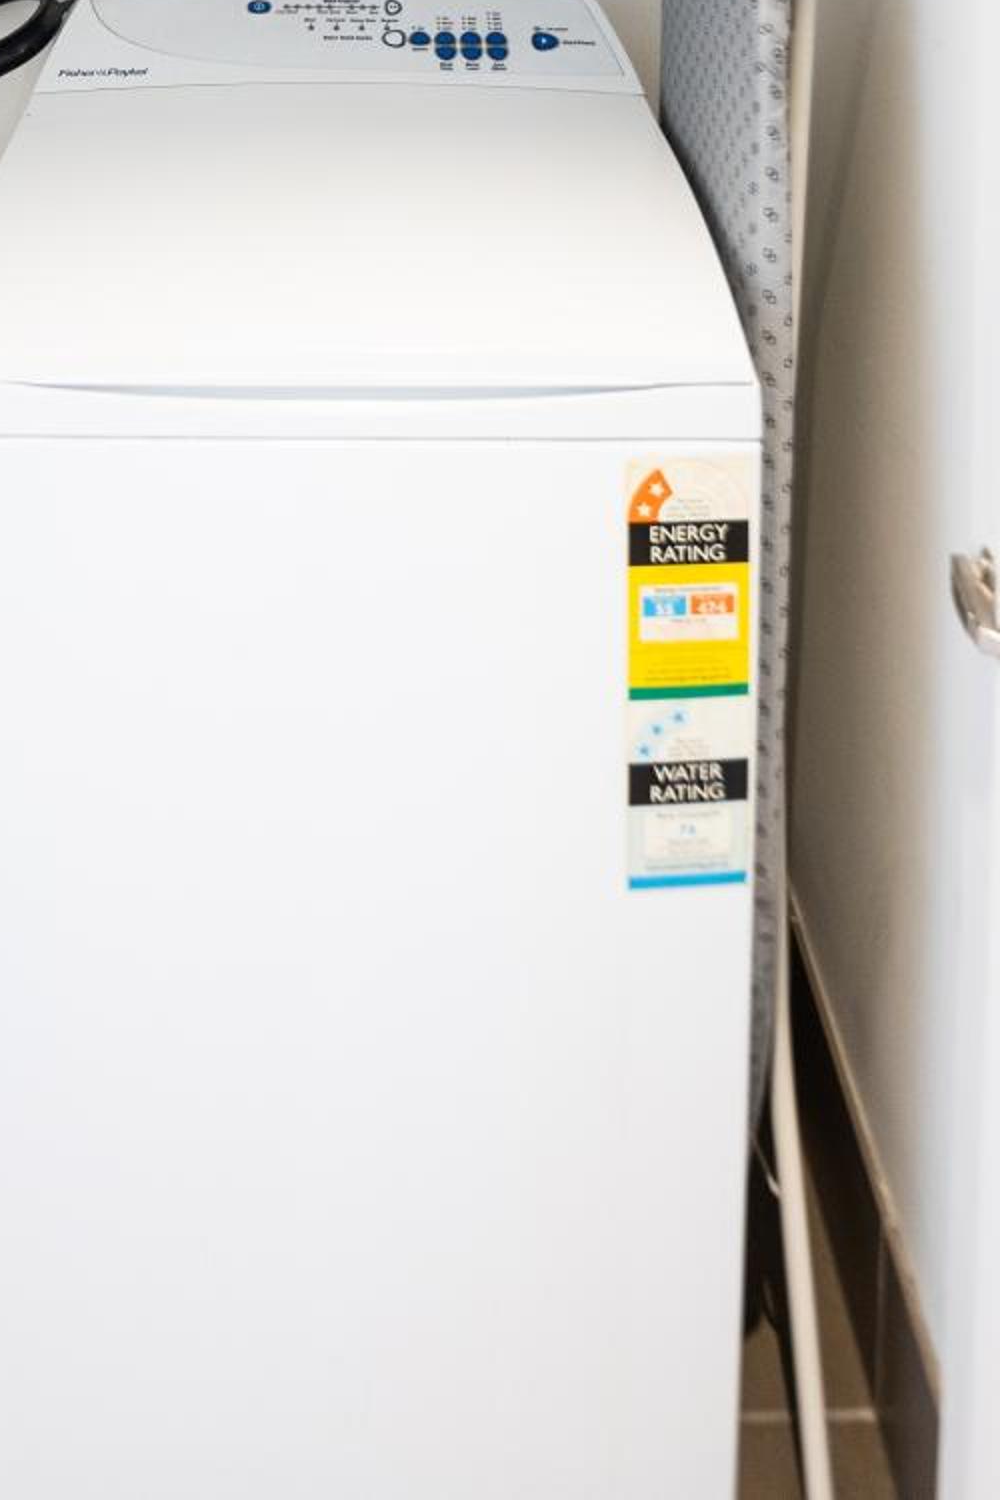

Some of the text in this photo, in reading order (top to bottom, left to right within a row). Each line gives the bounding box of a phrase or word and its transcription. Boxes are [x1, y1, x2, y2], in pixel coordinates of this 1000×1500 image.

[650, 524, 729, 544] ENERGY
[650, 544, 726, 564] RATING
[653, 762, 725, 782] WATER
[650, 782, 726, 803] RATING
